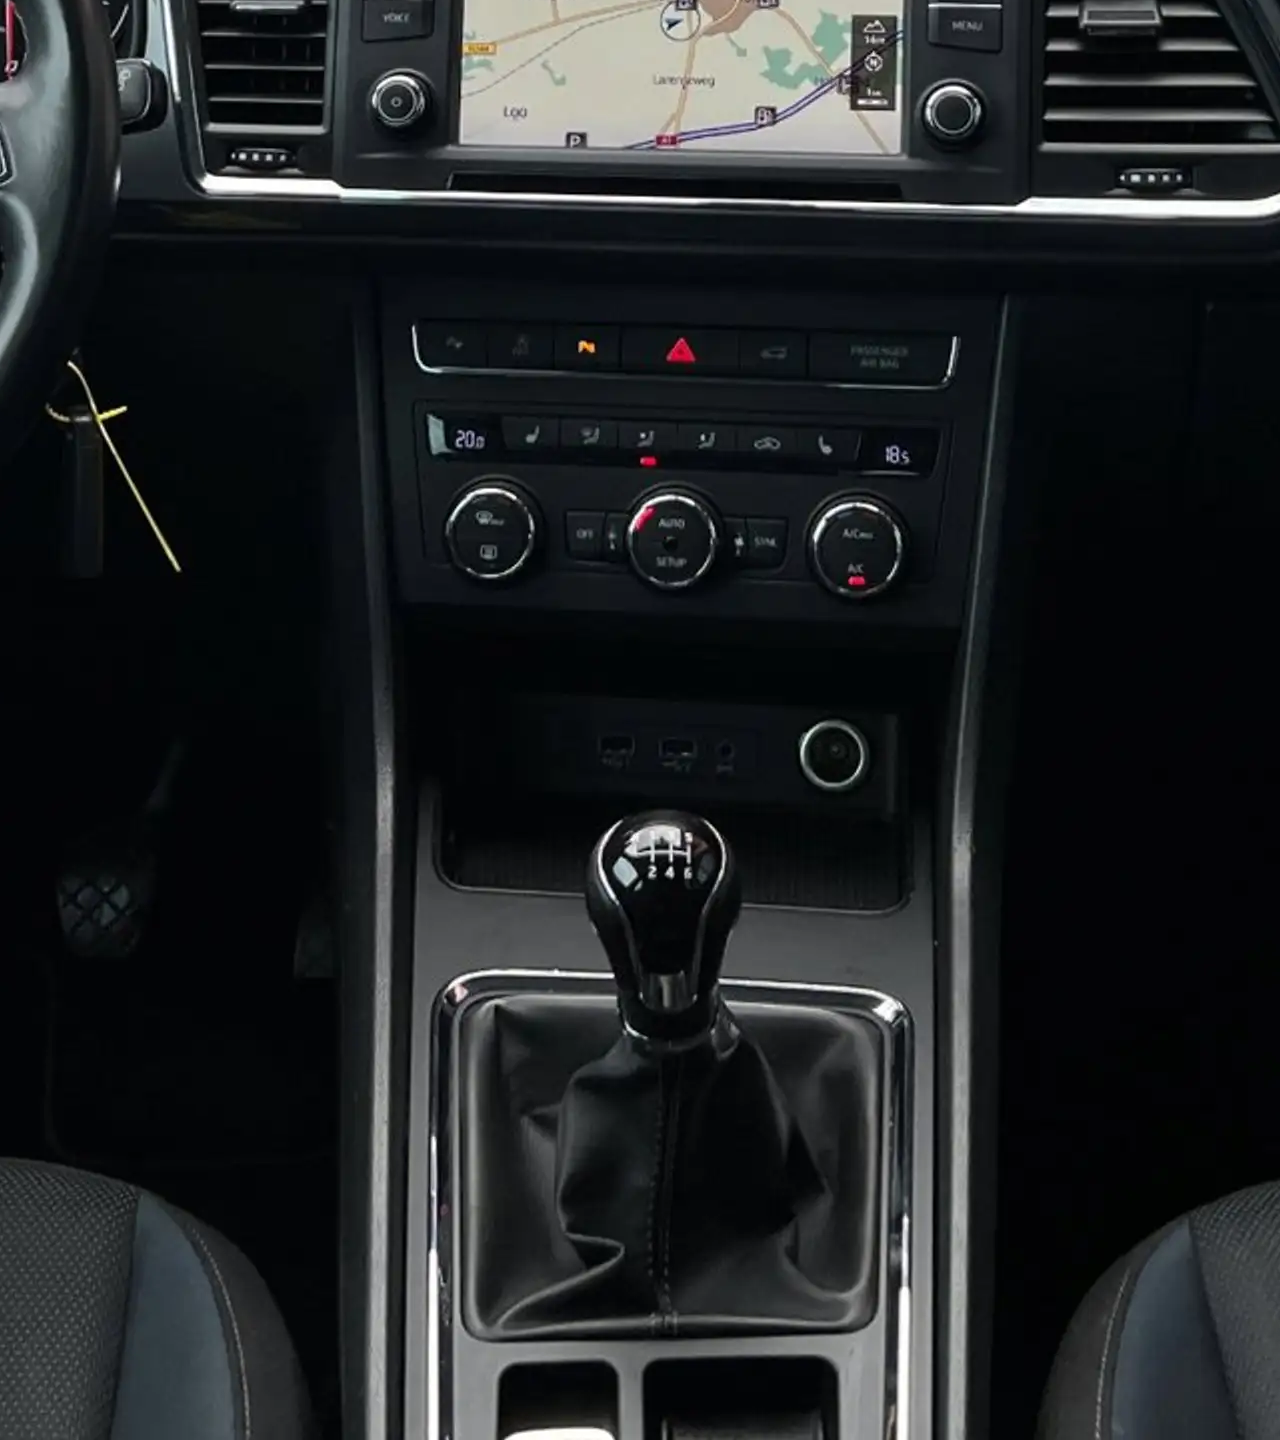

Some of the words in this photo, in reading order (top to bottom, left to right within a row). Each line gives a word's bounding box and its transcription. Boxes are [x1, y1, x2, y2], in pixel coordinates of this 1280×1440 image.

[382, 12, 411, 23] VOICE
[951, 20, 983, 32] MENU
[658, 517, 685, 529] AUTO
[647, 865, 657, 879] 2
[664, 865, 675, 879] 4
